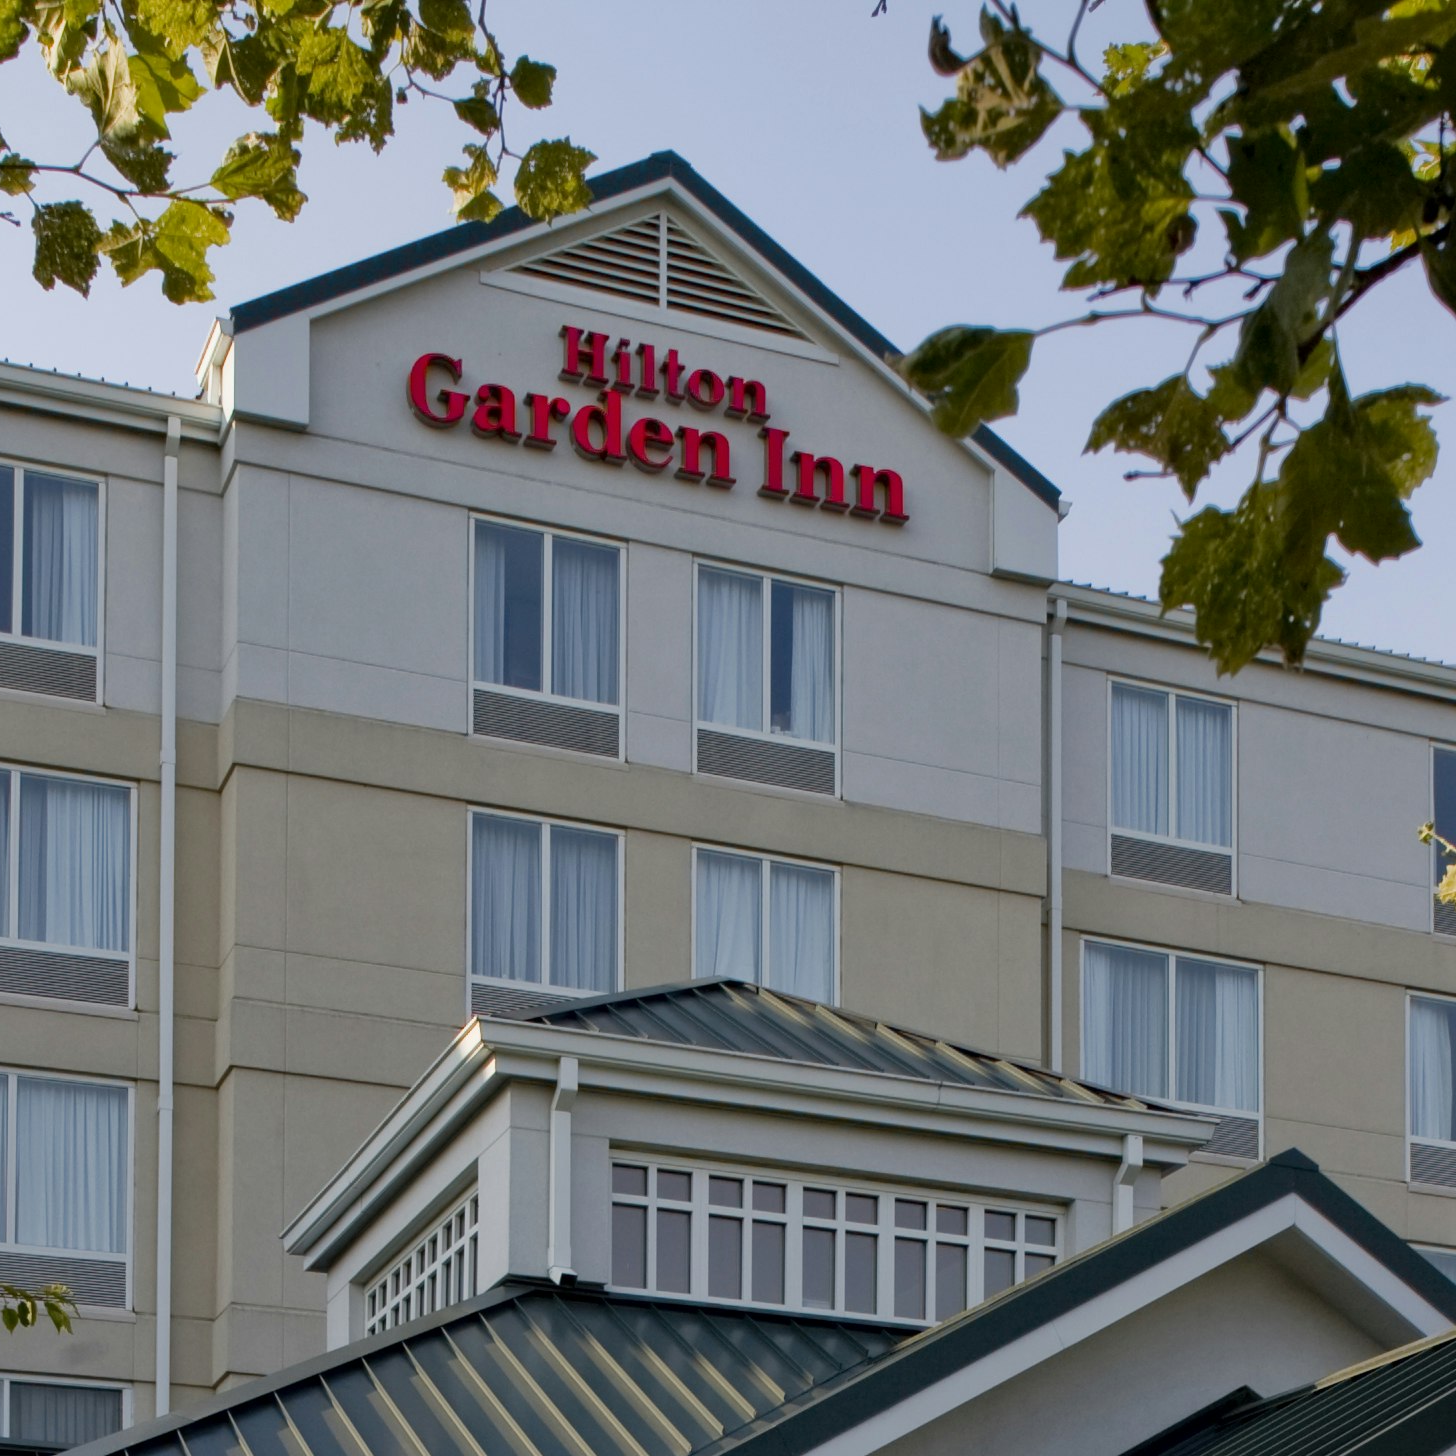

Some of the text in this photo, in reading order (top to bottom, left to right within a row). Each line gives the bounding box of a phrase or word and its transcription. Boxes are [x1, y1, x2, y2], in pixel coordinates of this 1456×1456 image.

[407, 352, 910, 525] Garden Inn
[558, 324, 771, 422] Hilton
